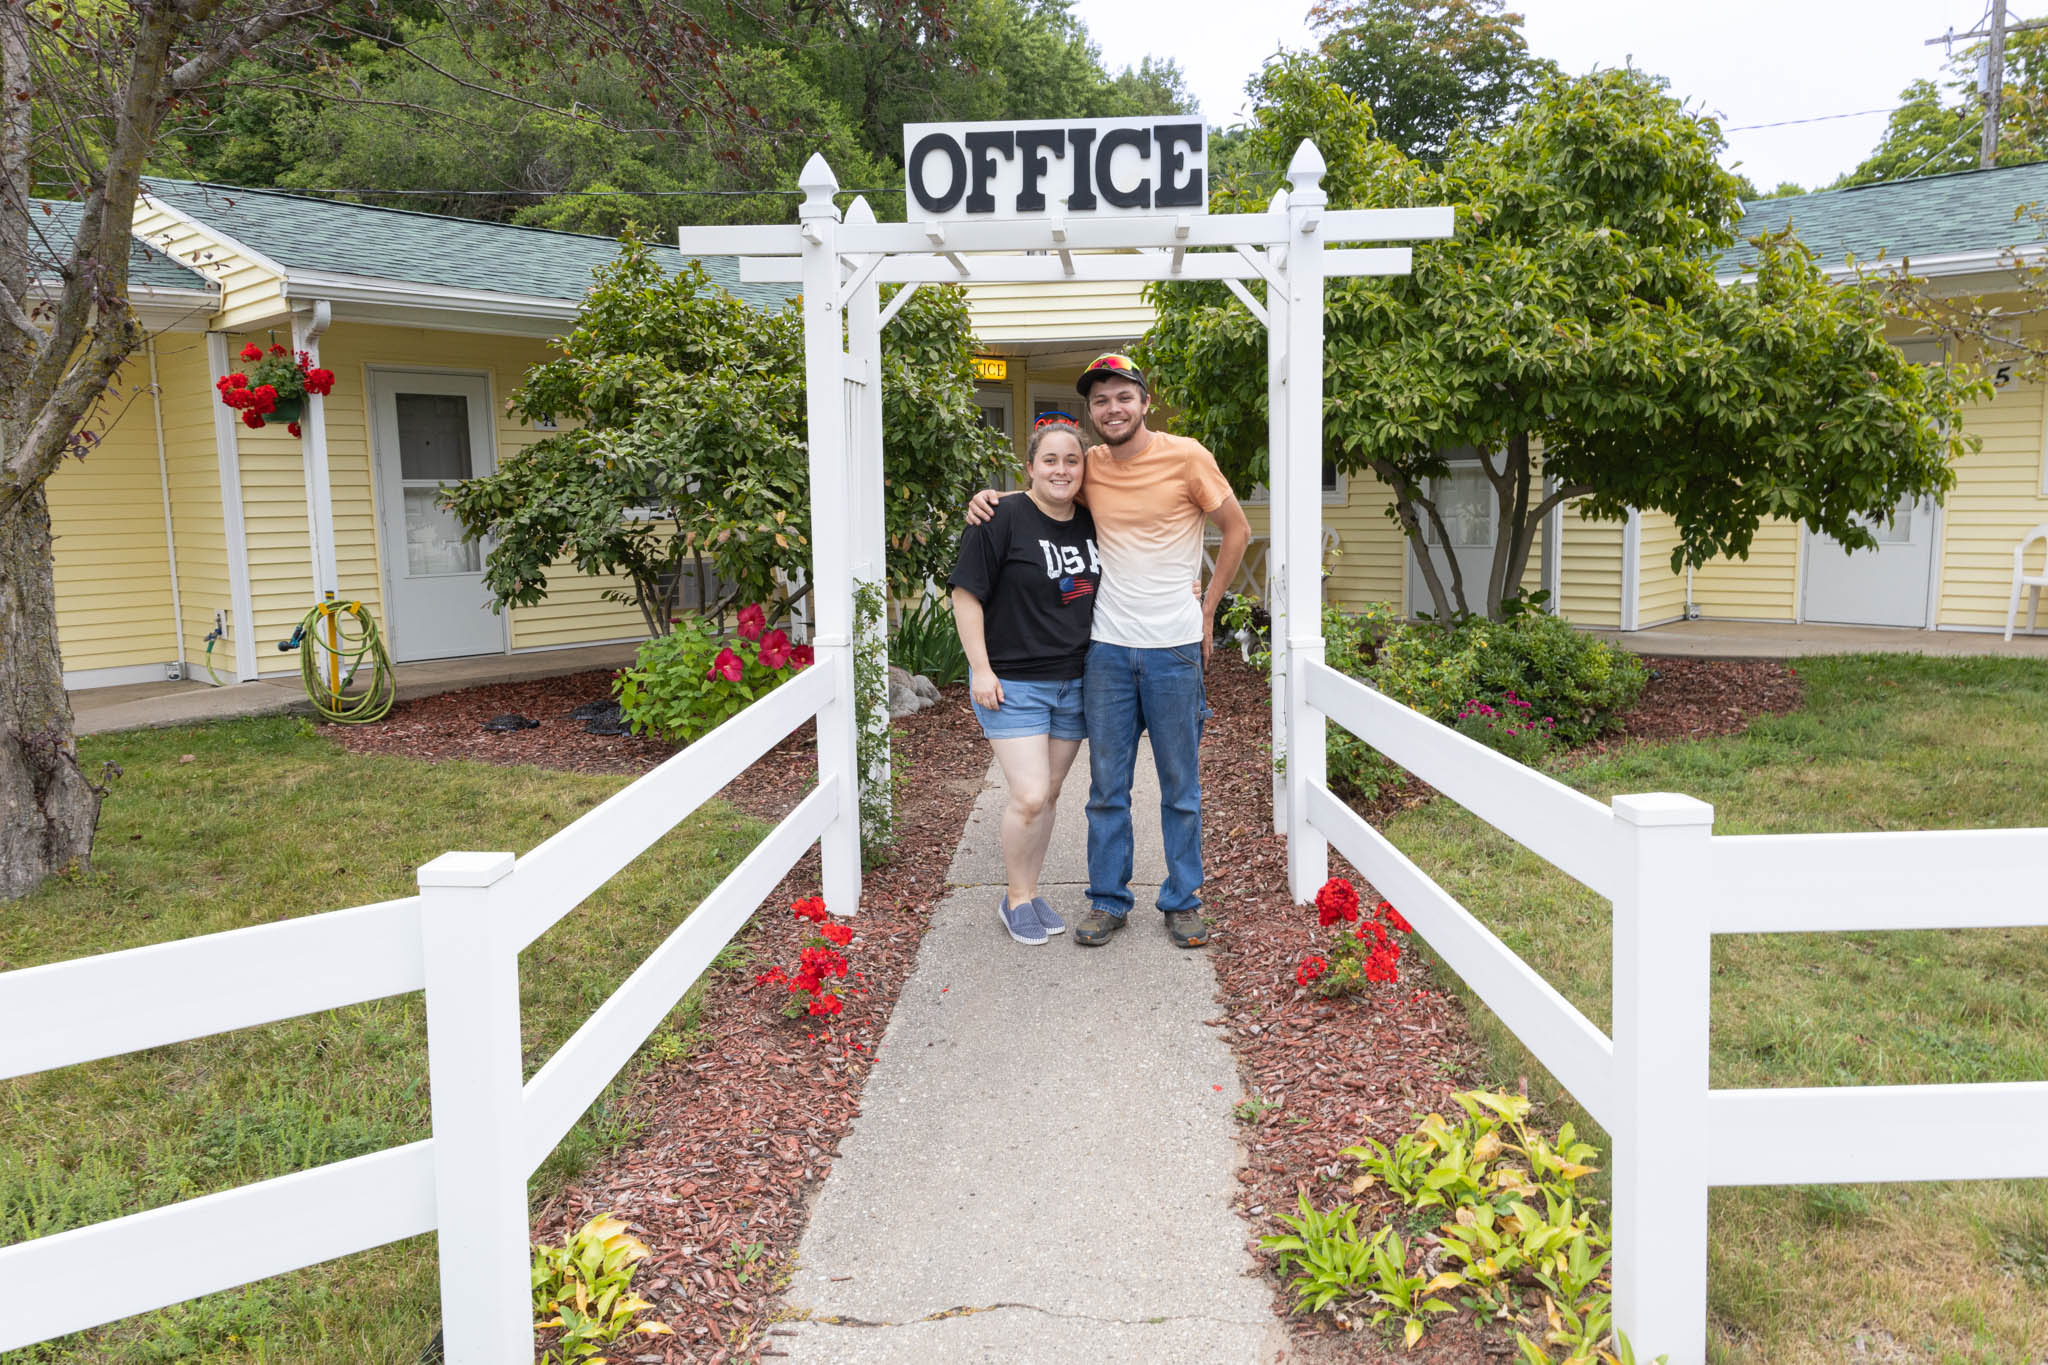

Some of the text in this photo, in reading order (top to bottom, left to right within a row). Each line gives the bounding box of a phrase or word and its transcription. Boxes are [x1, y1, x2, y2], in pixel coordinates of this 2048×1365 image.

[908, 123, 1203, 214] OFFICE
[976, 363, 1004, 377] ICE
[1994, 366, 2011, 387] 5
